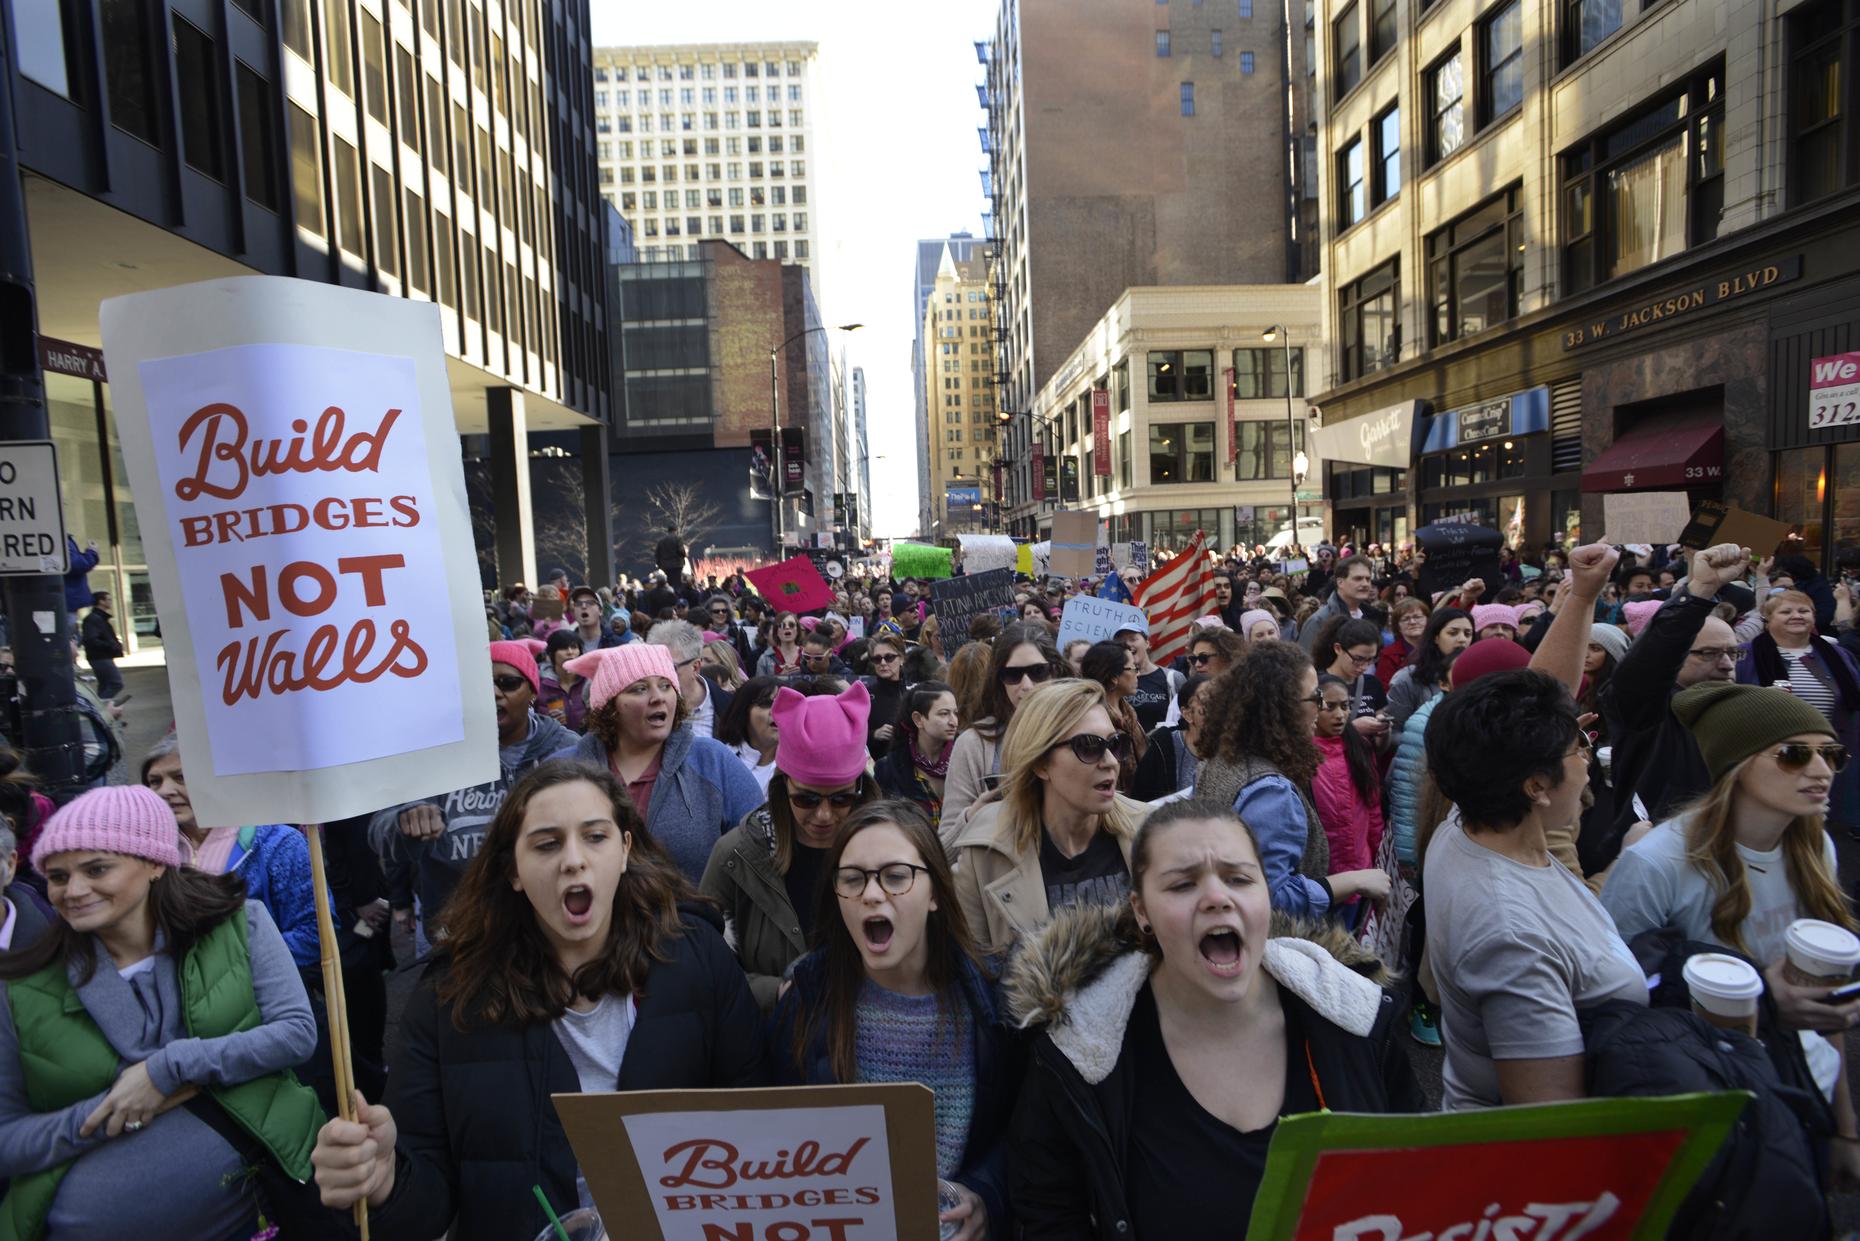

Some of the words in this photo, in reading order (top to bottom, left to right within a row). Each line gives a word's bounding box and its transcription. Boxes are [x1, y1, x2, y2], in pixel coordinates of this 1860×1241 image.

[1567, 329, 1584, 347] 33
[1591, 321, 1610, 339] W.
[1619, 289, 1705, 330] JACKSON
[1717, 265, 1779, 299] BLVD
[47, 350, 88, 375] HARRY
[1815, 359, 1857, 383] We
[175, 403, 402, 502] Build
[1360, 408, 1403, 461] Garrett
[1685, 467, 1704, 478] 33
[180, 494, 421, 548] BRIDGES
[4, 533, 55, 557] RED
[220, 553, 406, 628] NOT
[1073, 600, 1123, 623] TRUTH
[216, 618, 428, 706] Walls
[659, 1137, 872, 1189] Build
[663, 1186, 881, 1212] BRIDGES
[701, 1217, 865, 1241] NOT
